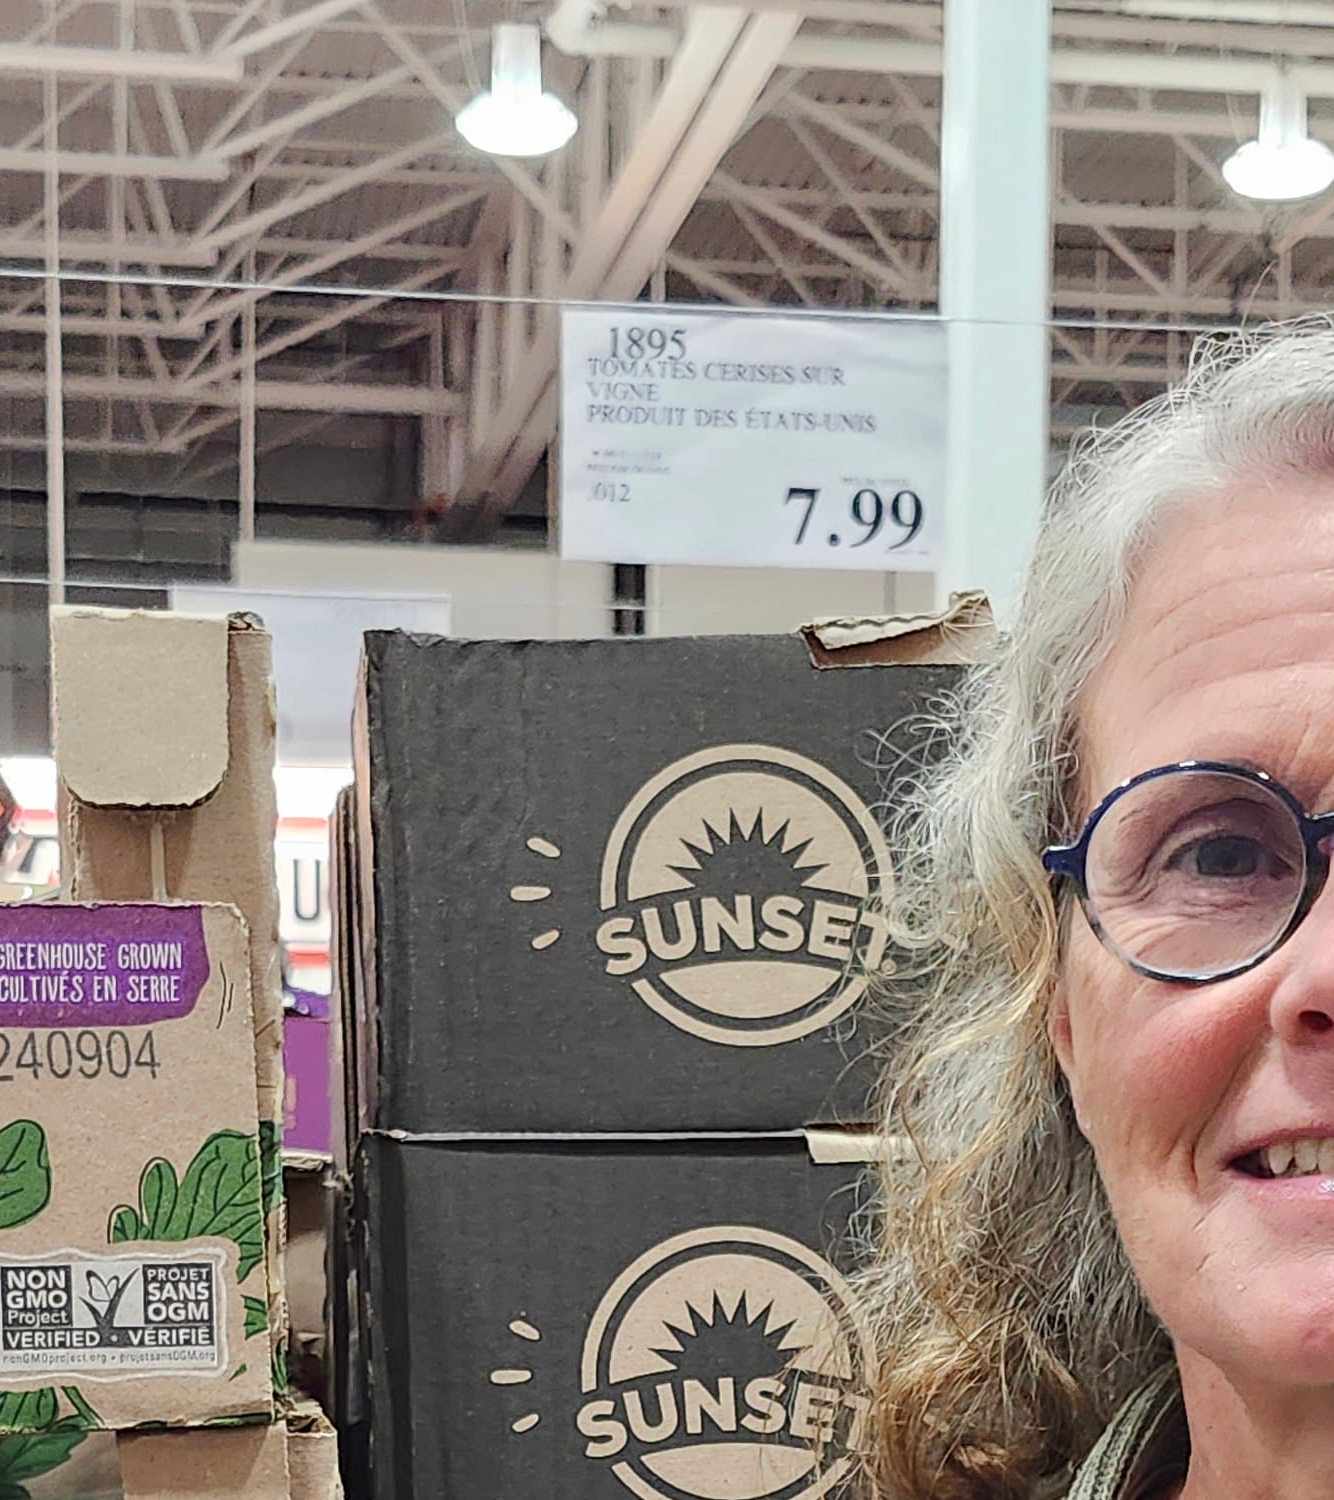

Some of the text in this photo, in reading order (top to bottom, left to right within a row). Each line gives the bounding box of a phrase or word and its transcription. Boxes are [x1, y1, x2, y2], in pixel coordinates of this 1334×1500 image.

[609, 327, 687, 361] 1895
[587, 358, 846, 387] TOMATES CERISES SUR
[586, 382, 659, 402] VIGNE
[587, 404, 685, 427] PRODUIT
[695, 409, 738, 428] DES
[783, 487, 925, 550] 7.99
[117, 942, 183, 970] GROWN
[92, 975, 117, 1002] EN
[126, 974, 180, 1003] SERRE
[6, 1269, 66, 1290] NON
[147, 1267, 209, 1281] PROJET
[5, 1290, 68, 1309] GMO
[147, 1282, 210, 1301] SANS
[7, 1309, 69, 1328] Project
[147, 1301, 209, 1322] OGM
[6, 1326, 211, 1348] VERIFIED VÉRIFIÉ
